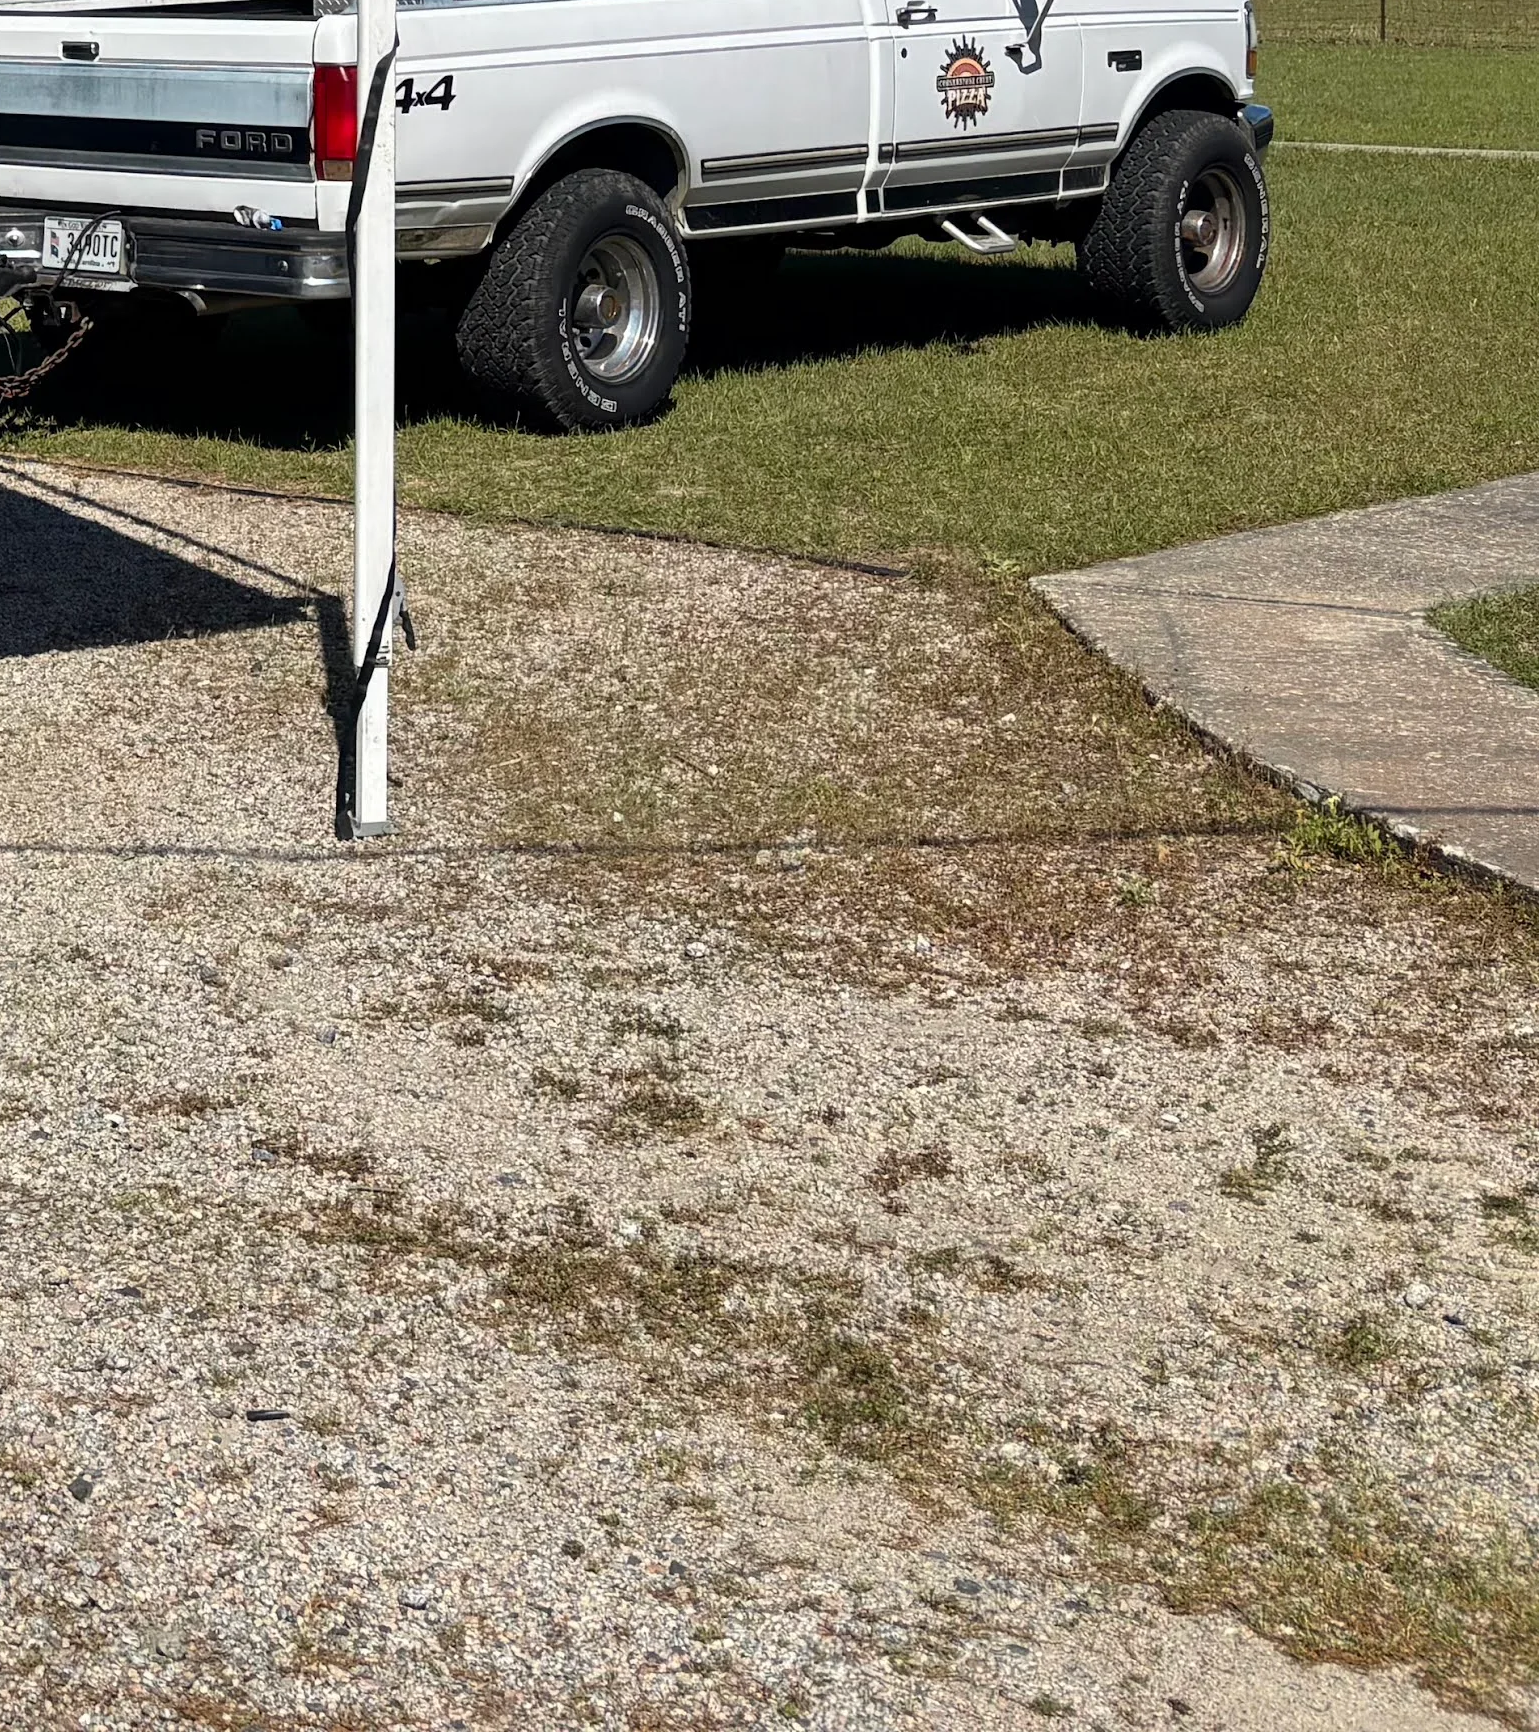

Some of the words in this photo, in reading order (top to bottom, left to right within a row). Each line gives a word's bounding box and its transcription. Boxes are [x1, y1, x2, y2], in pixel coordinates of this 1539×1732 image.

[947, 86, 986, 111] PIZZA
[196, 129, 292, 153] FORD
[625, 204, 685, 283] GRABBER
[559, 298, 617, 412] GENERAL
